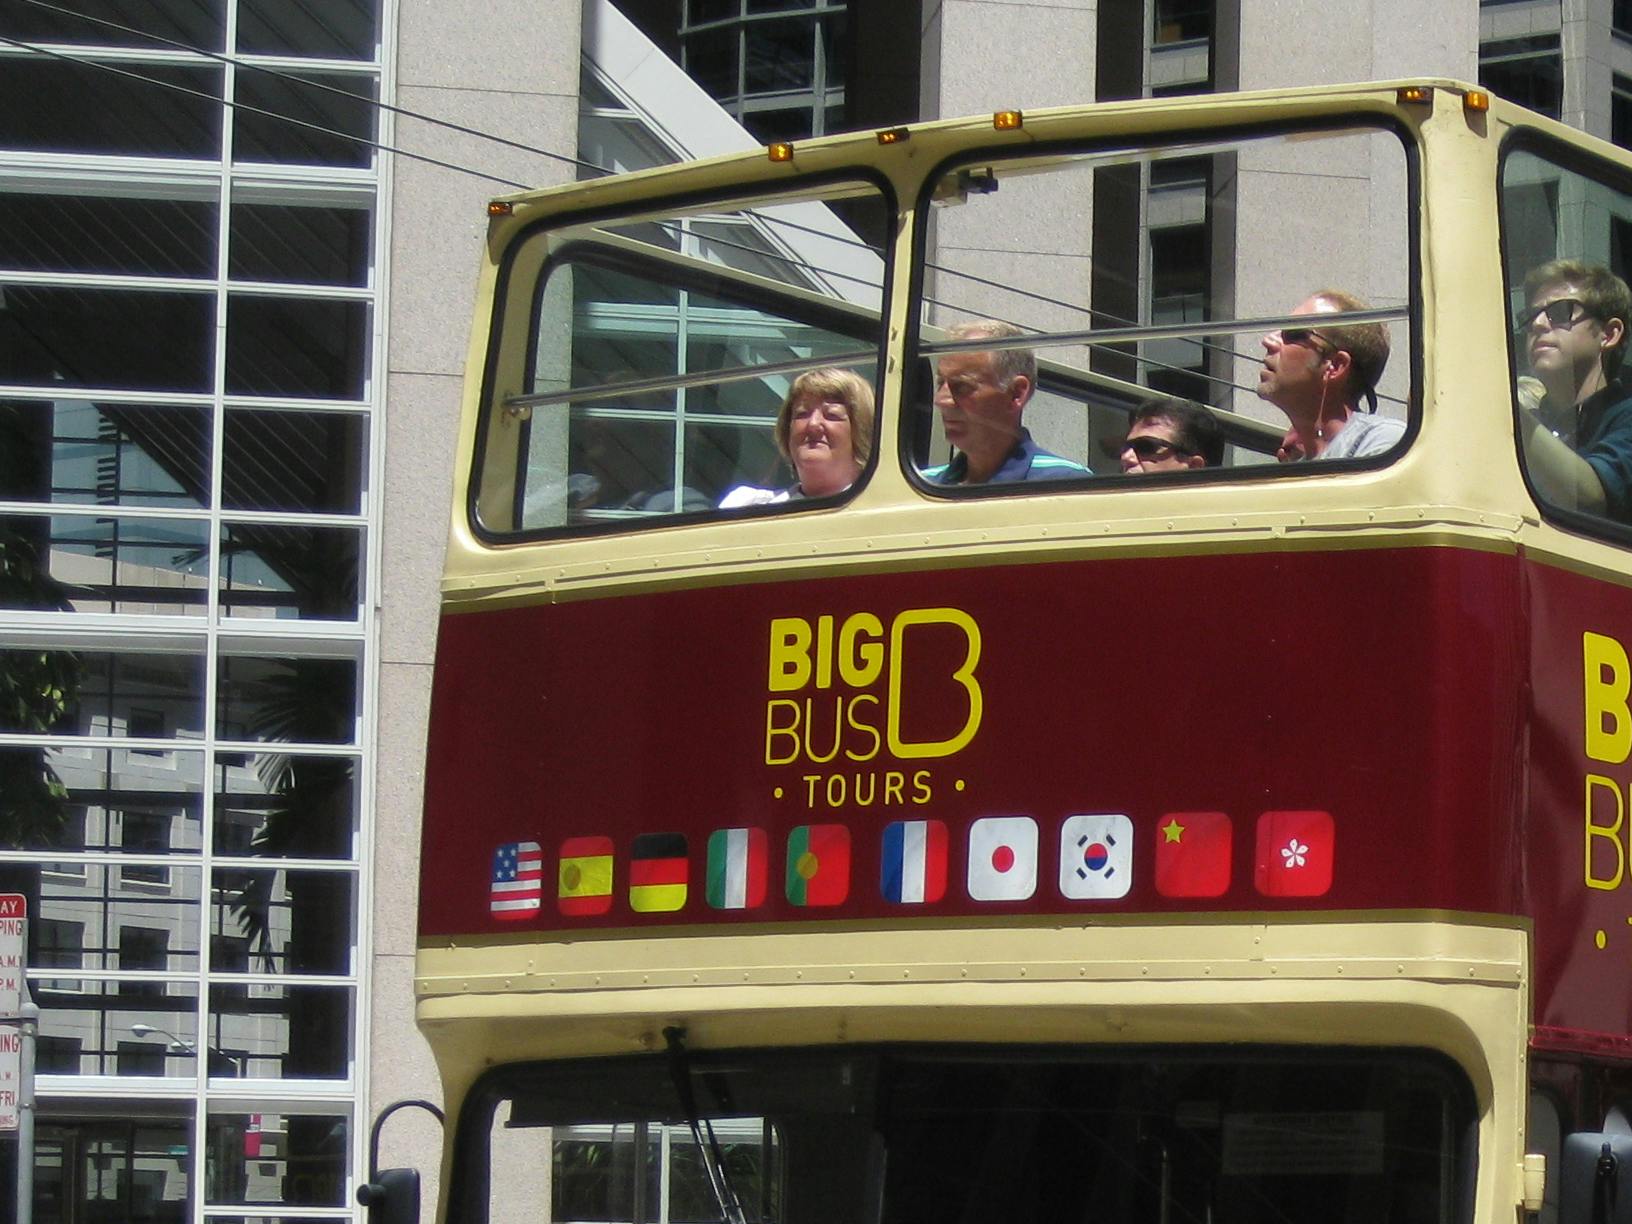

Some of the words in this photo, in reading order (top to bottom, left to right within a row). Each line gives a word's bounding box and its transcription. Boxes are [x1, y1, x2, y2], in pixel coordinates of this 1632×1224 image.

[769, 612, 884, 691] BIG
[766, 694, 881, 765] BUS
[803, 770, 932, 808] TOURS
